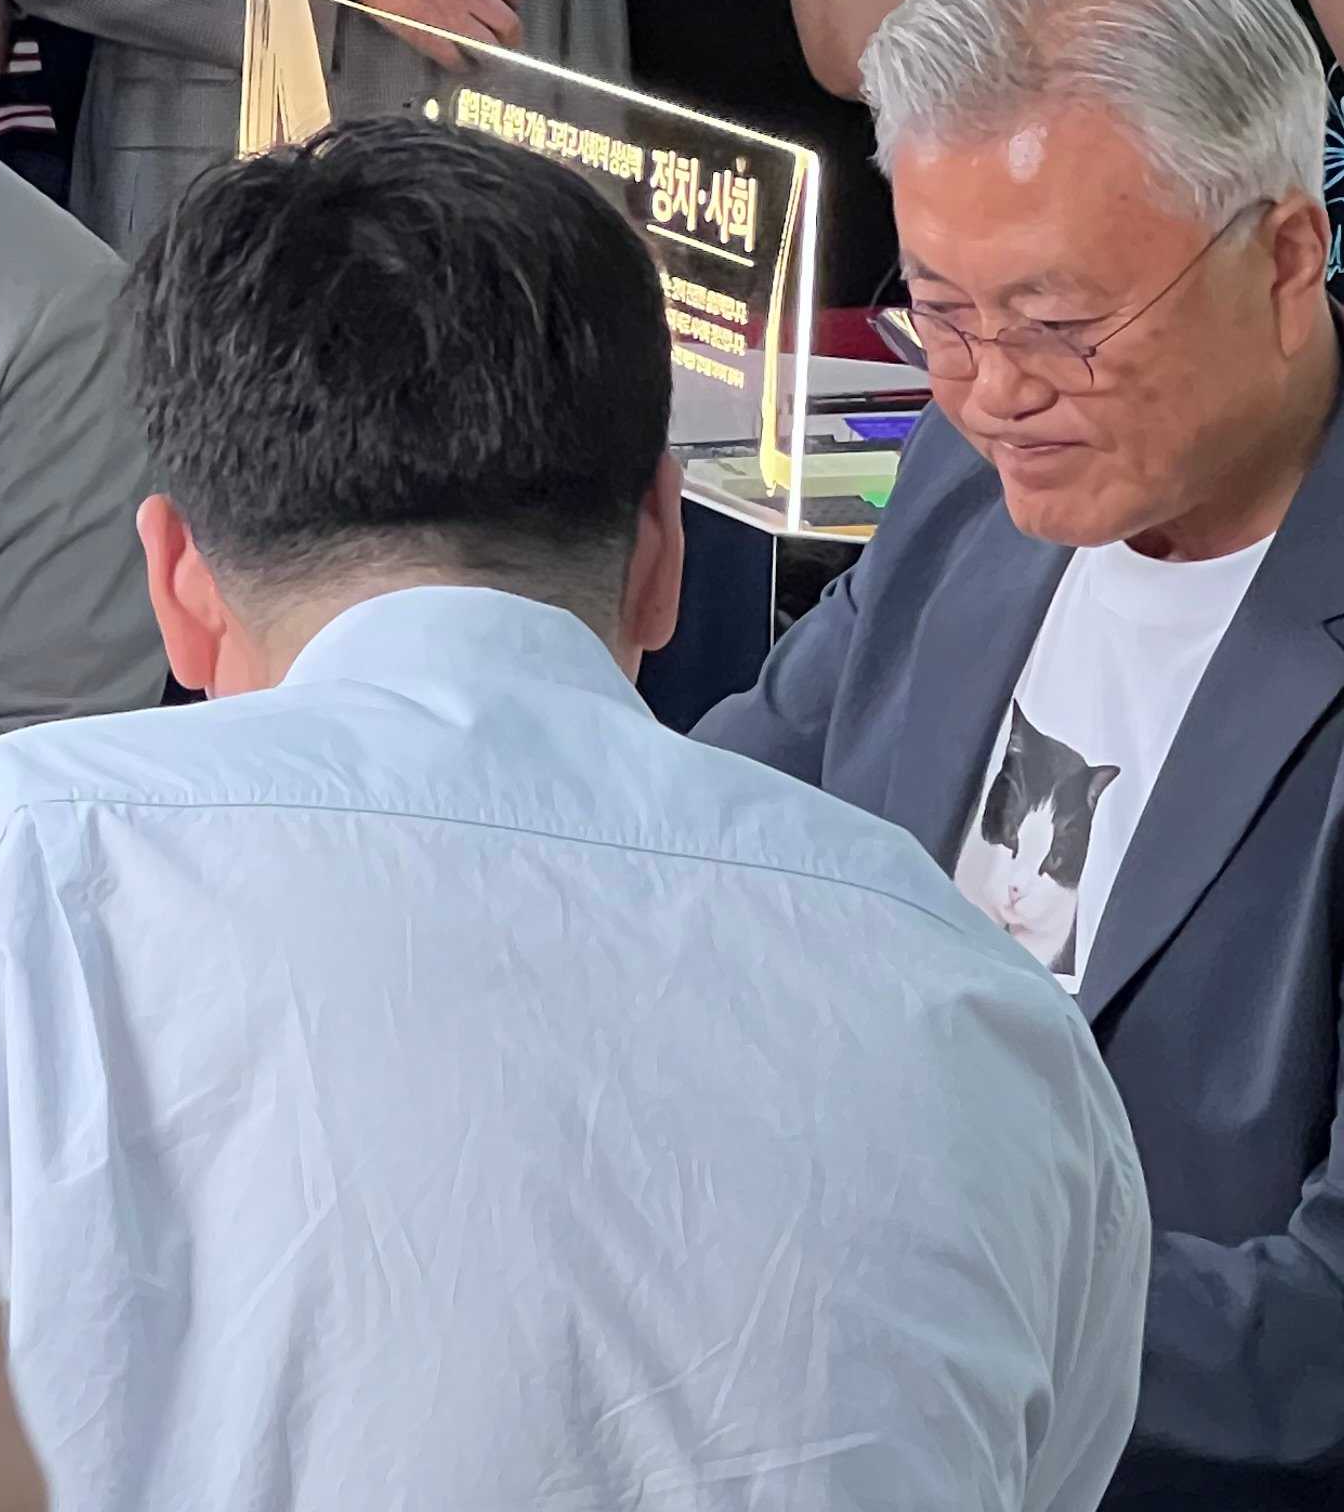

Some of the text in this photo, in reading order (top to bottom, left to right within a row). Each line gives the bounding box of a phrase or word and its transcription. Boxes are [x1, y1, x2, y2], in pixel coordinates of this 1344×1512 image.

[546, 119, 579, 158] 그리고
[579, 129, 610, 171] 사회적
[609, 140, 643, 182] 상상력
[650, 150, 757, 252] 정치·사회
